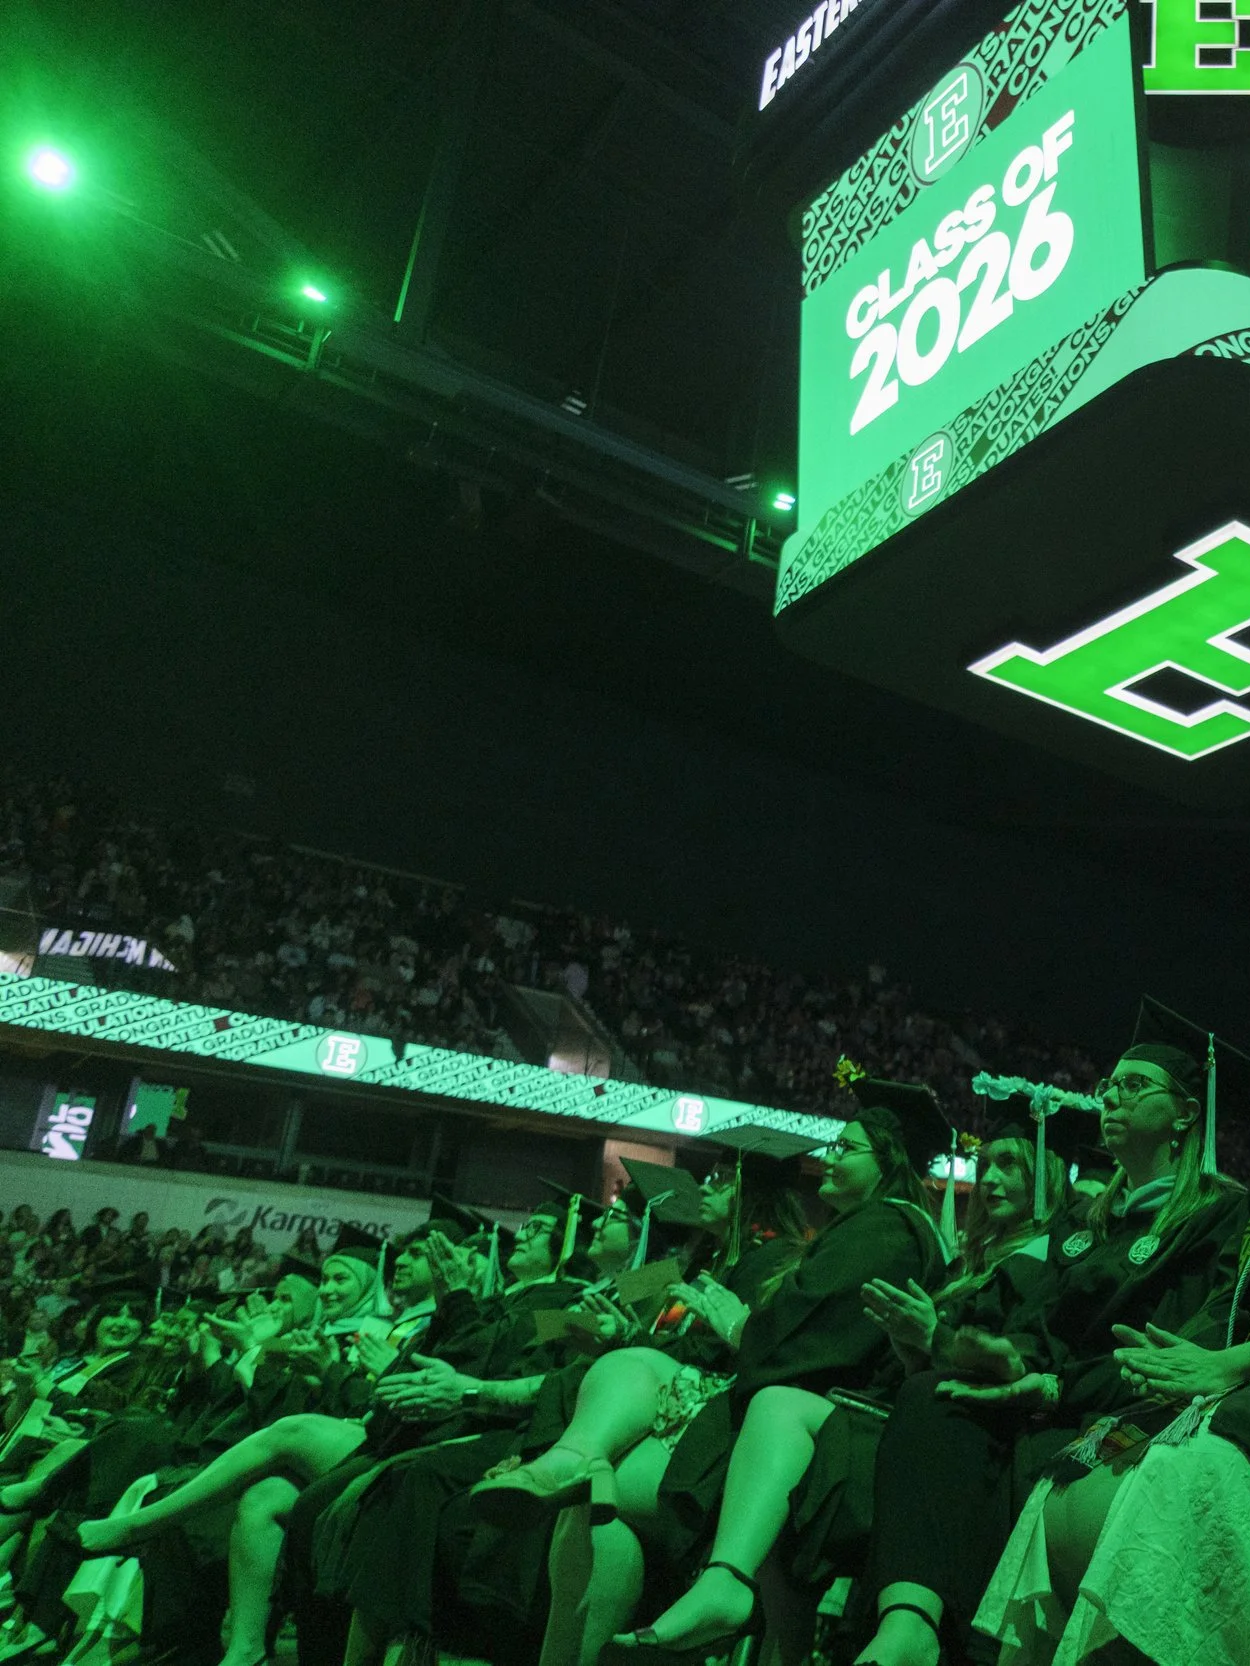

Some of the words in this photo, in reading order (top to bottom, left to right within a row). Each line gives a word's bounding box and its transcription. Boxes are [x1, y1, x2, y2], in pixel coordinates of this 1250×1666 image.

[846, 184, 996, 339] CLASS
[1002, 109, 1075, 206] OF
[850, 181, 1074, 436] 2026
